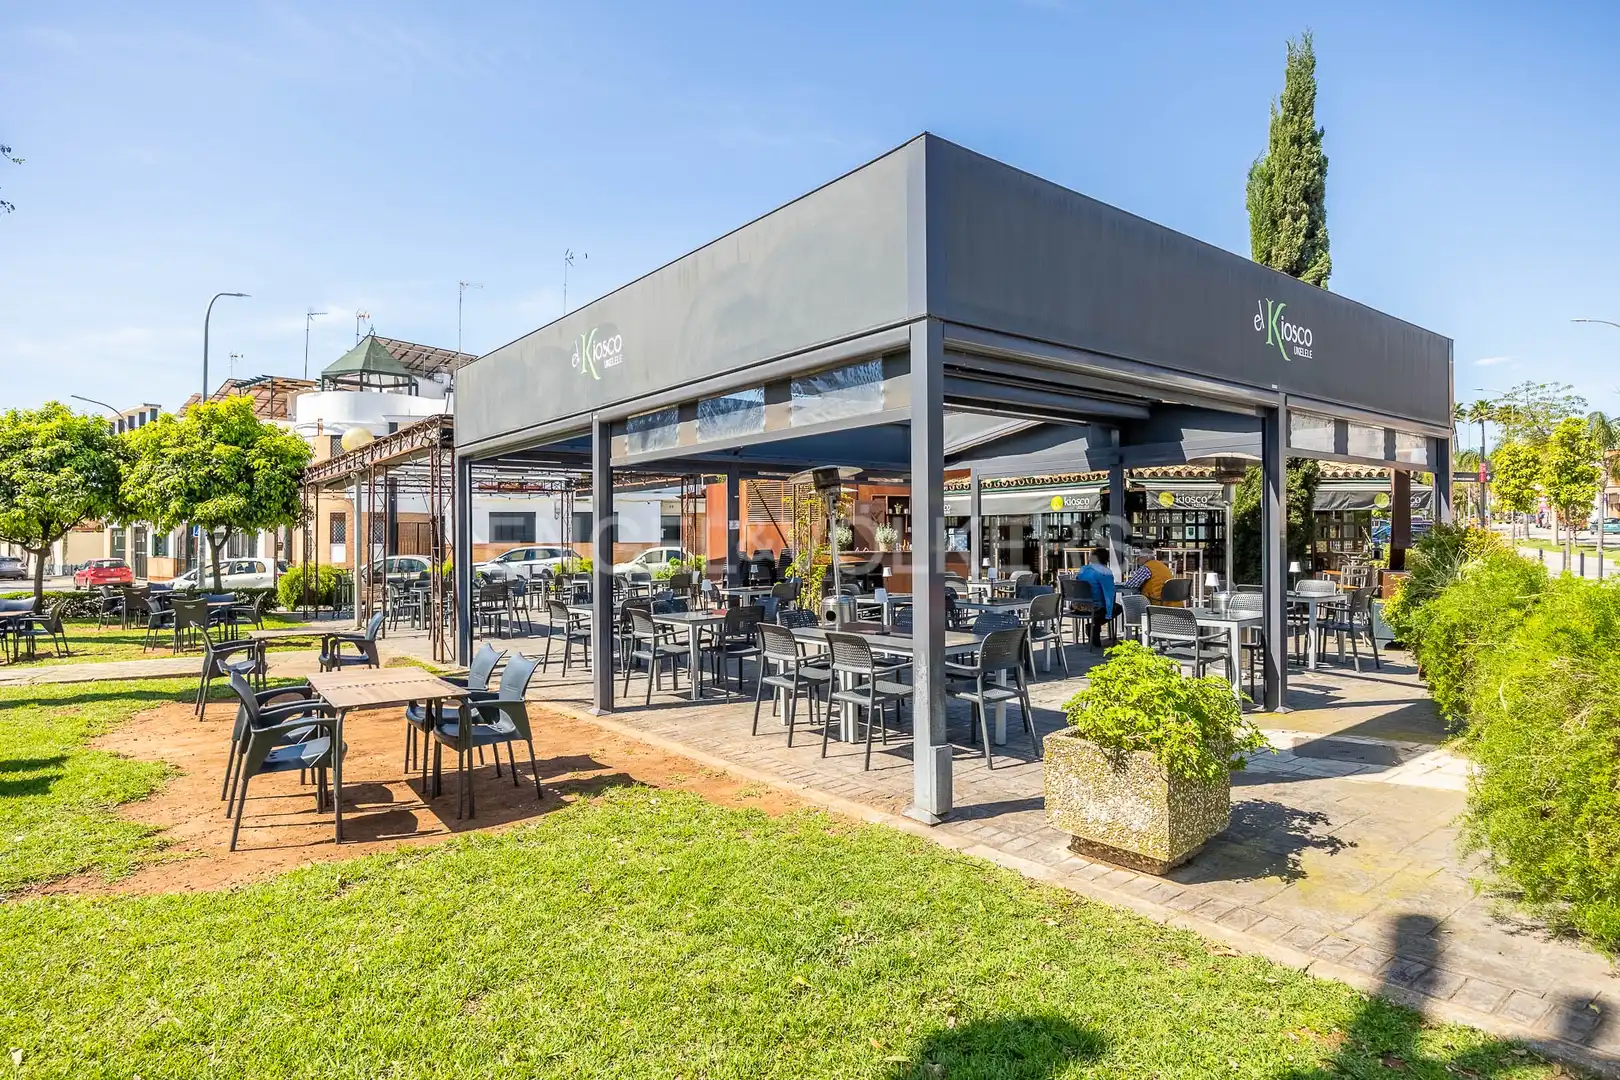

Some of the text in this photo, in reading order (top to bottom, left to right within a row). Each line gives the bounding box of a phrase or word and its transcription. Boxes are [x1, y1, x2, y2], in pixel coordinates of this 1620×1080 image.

[1254, 297, 1313, 361] el Kiosco
[1063, 496, 1090, 506] kiosco
[1175, 493, 1208, 504] kiosco
